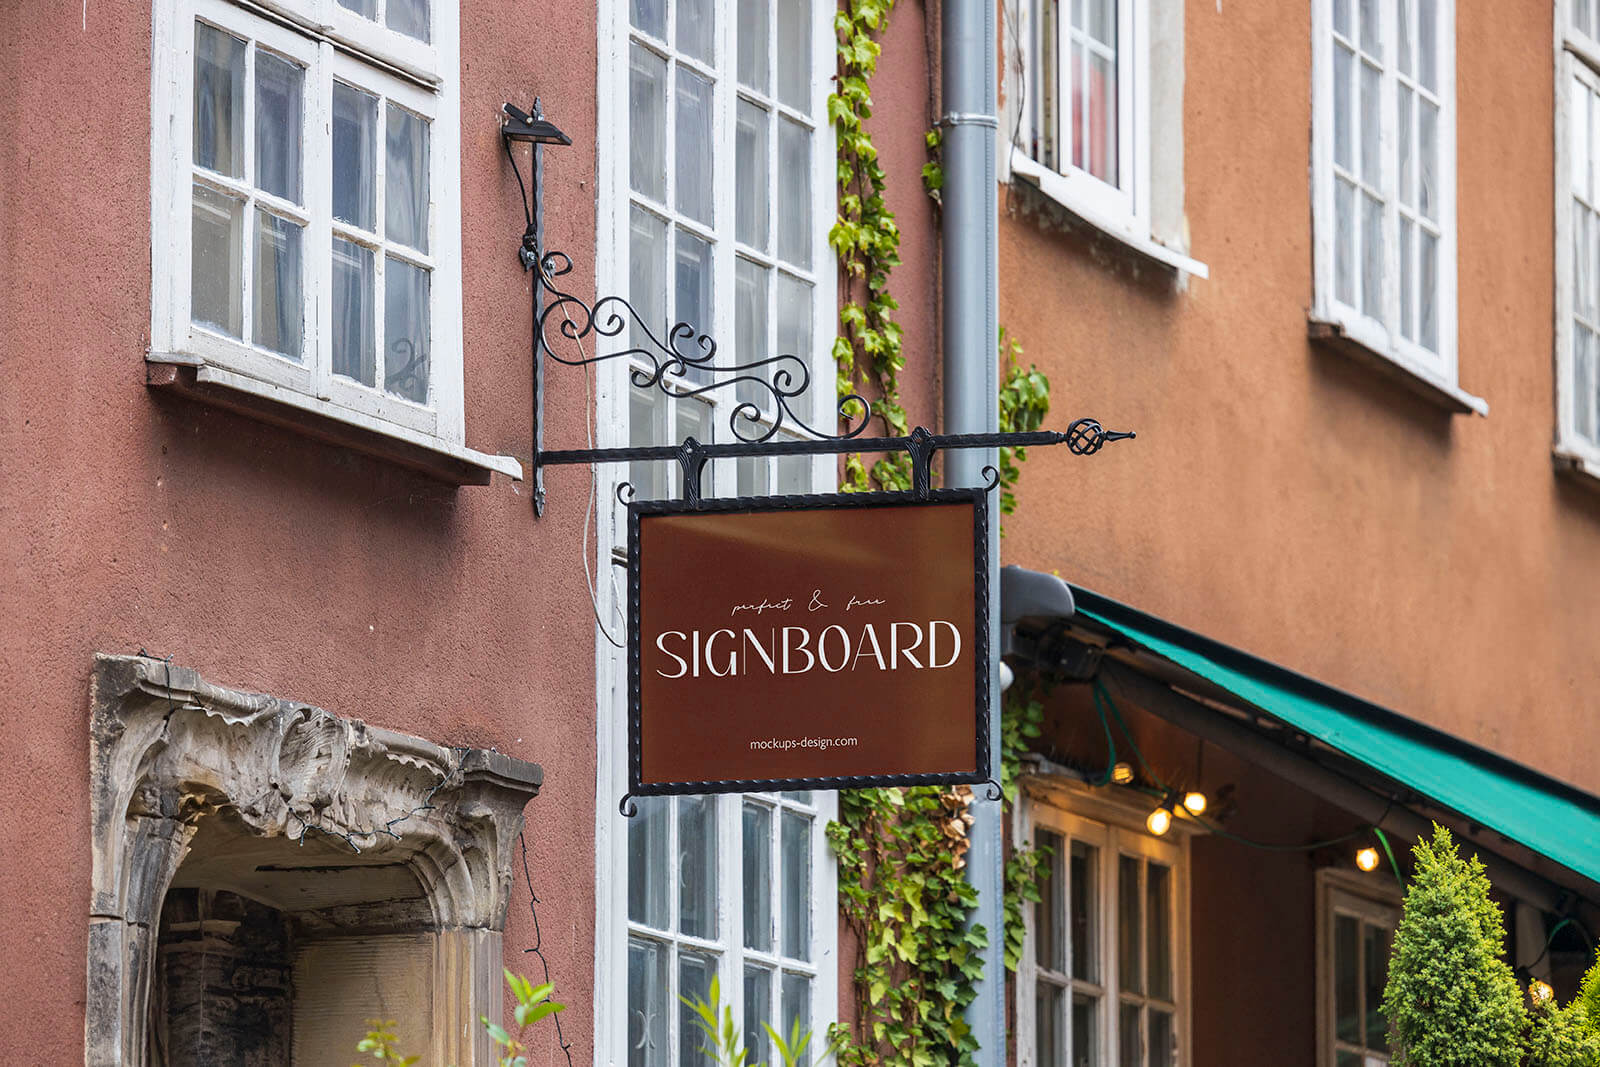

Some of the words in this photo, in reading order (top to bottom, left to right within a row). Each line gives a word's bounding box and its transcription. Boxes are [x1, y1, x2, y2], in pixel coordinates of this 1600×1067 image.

[731, 598, 793, 616] perfect
[807, 589, 829, 612] &
[845, 596, 886, 611] free
[655, 620, 962, 679] SIGNBOARD
[750, 736, 859, 751] mockups-design.com
